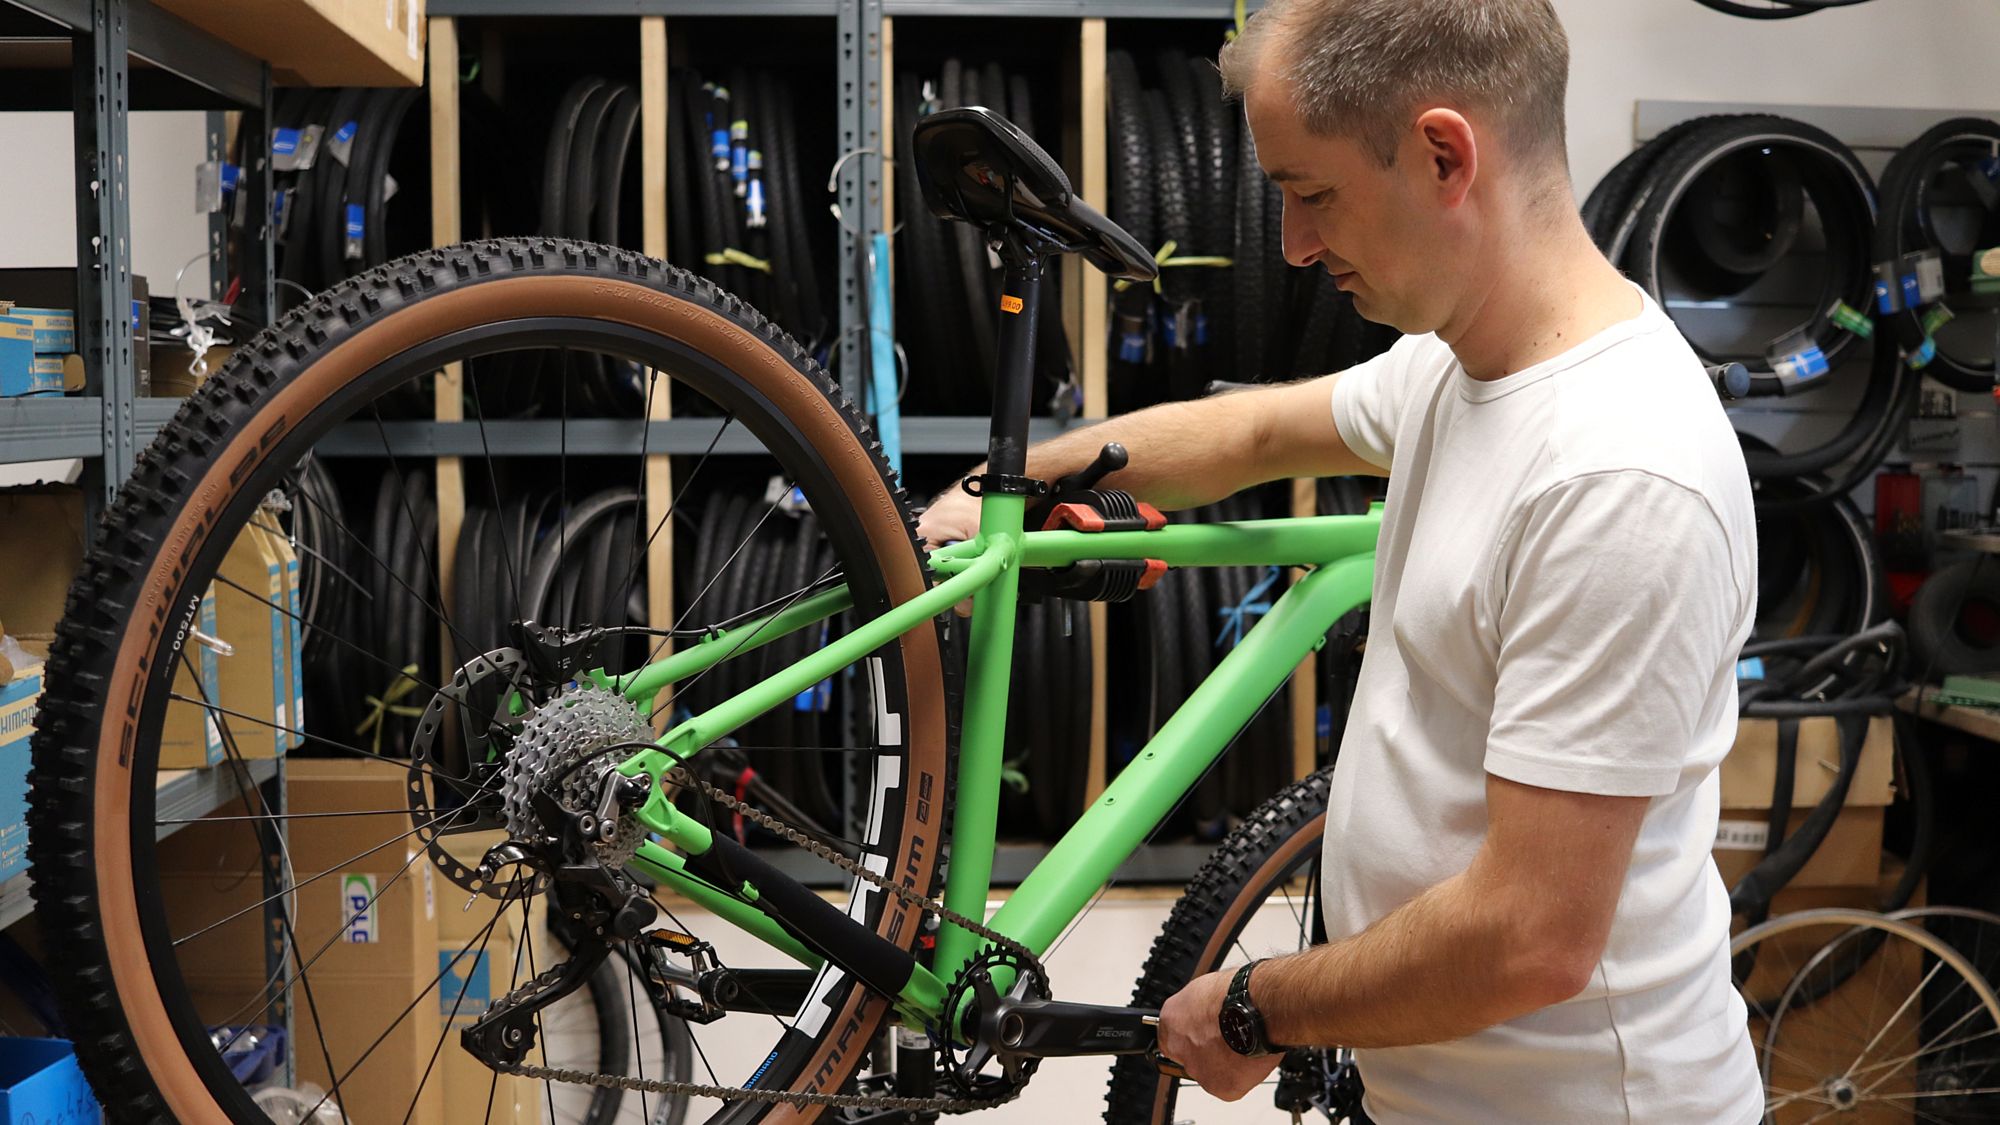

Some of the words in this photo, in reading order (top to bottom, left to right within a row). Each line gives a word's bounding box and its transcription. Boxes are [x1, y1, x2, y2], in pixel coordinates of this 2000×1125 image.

[119, 414, 288, 767] SCHWALBE
[172, 594, 200, 651] MT500
[0, 704, 38, 736] HIMAN
[885, 835, 925, 945] SAM
[1096, 1030, 1133, 1038] DEORE
[744, 1051, 779, 1089] SHIMANO
